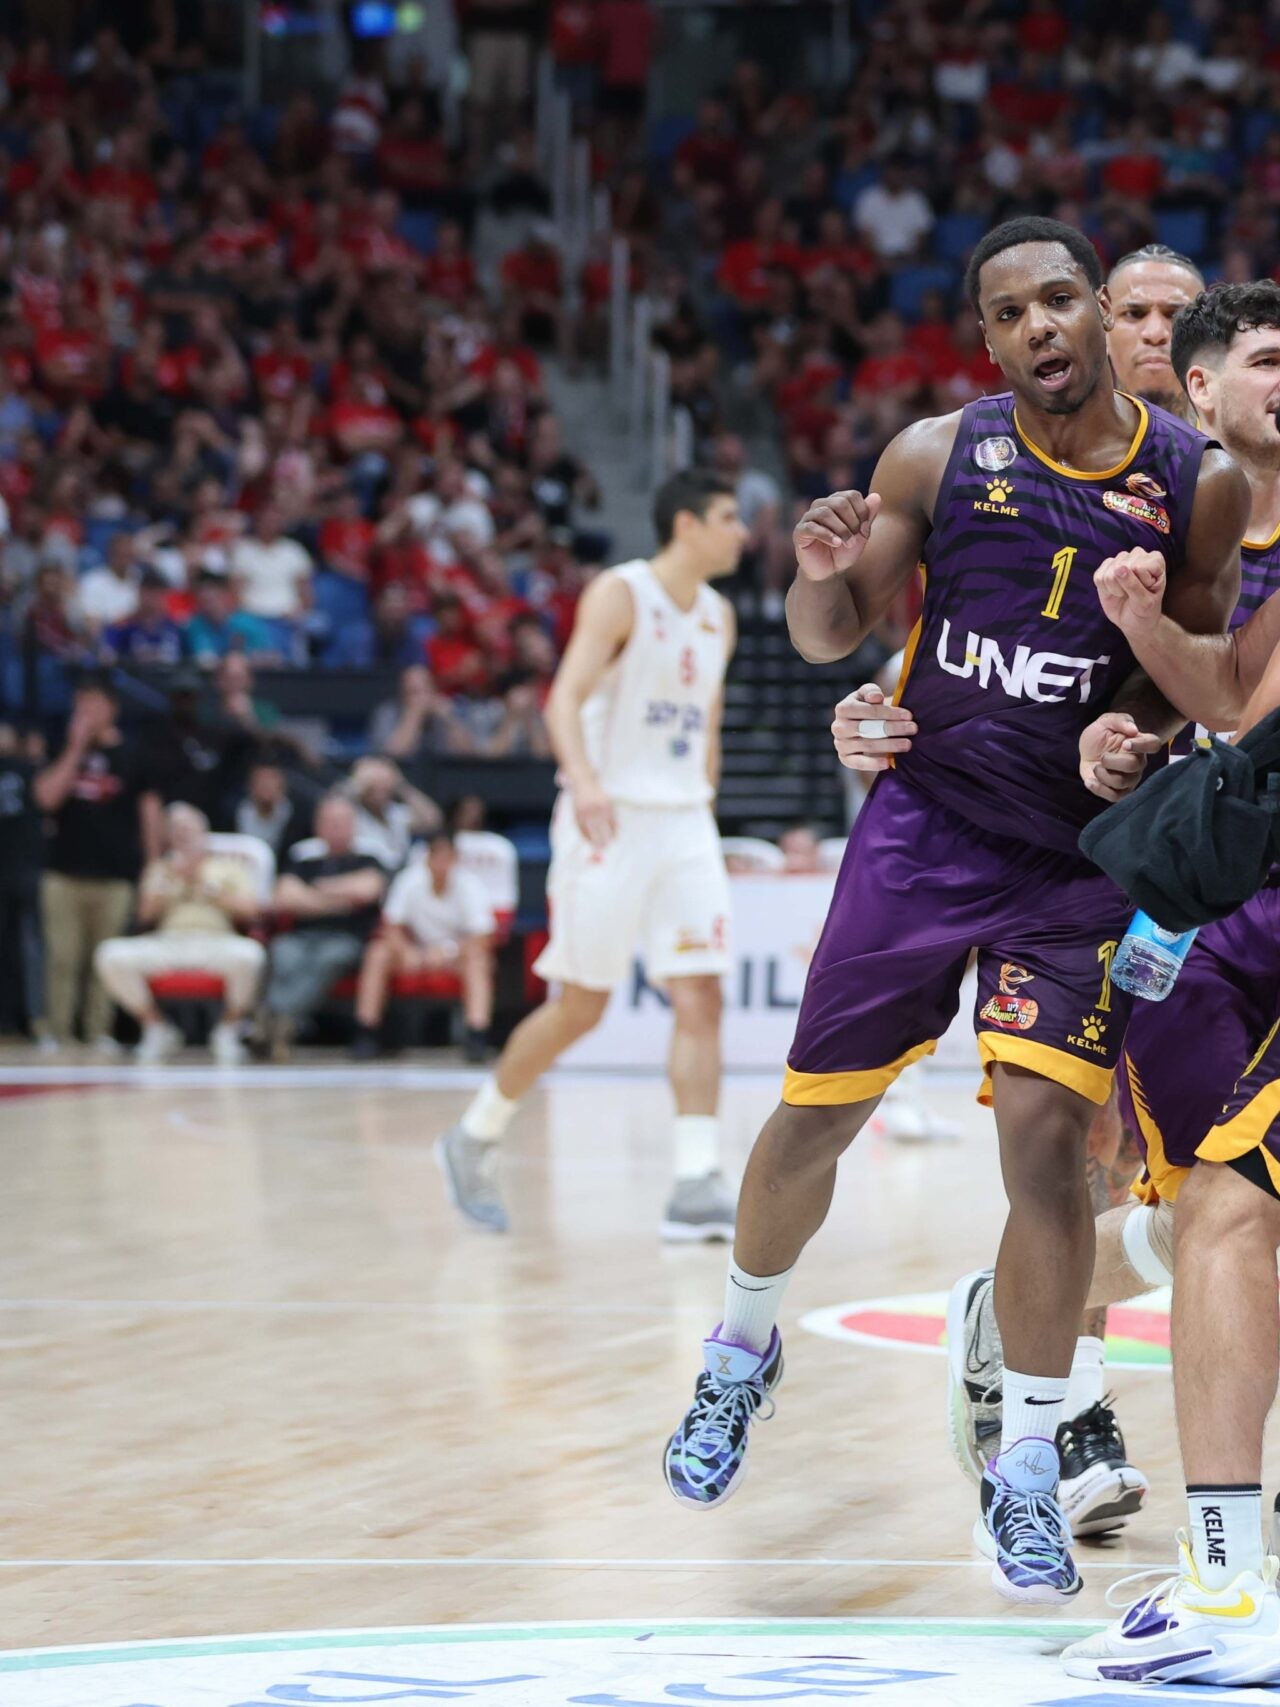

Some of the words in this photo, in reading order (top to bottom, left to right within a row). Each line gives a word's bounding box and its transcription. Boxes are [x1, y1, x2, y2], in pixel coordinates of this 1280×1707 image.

[973, 501, 1020, 517] KELME
[1041, 547, 1077, 619] 1
[936, 618, 1111, 703] UNET
[1095, 941, 1118, 1011] 1
[1067, 1035, 1106, 1055] KELME
[1201, 1506, 1227, 1567] KELME
